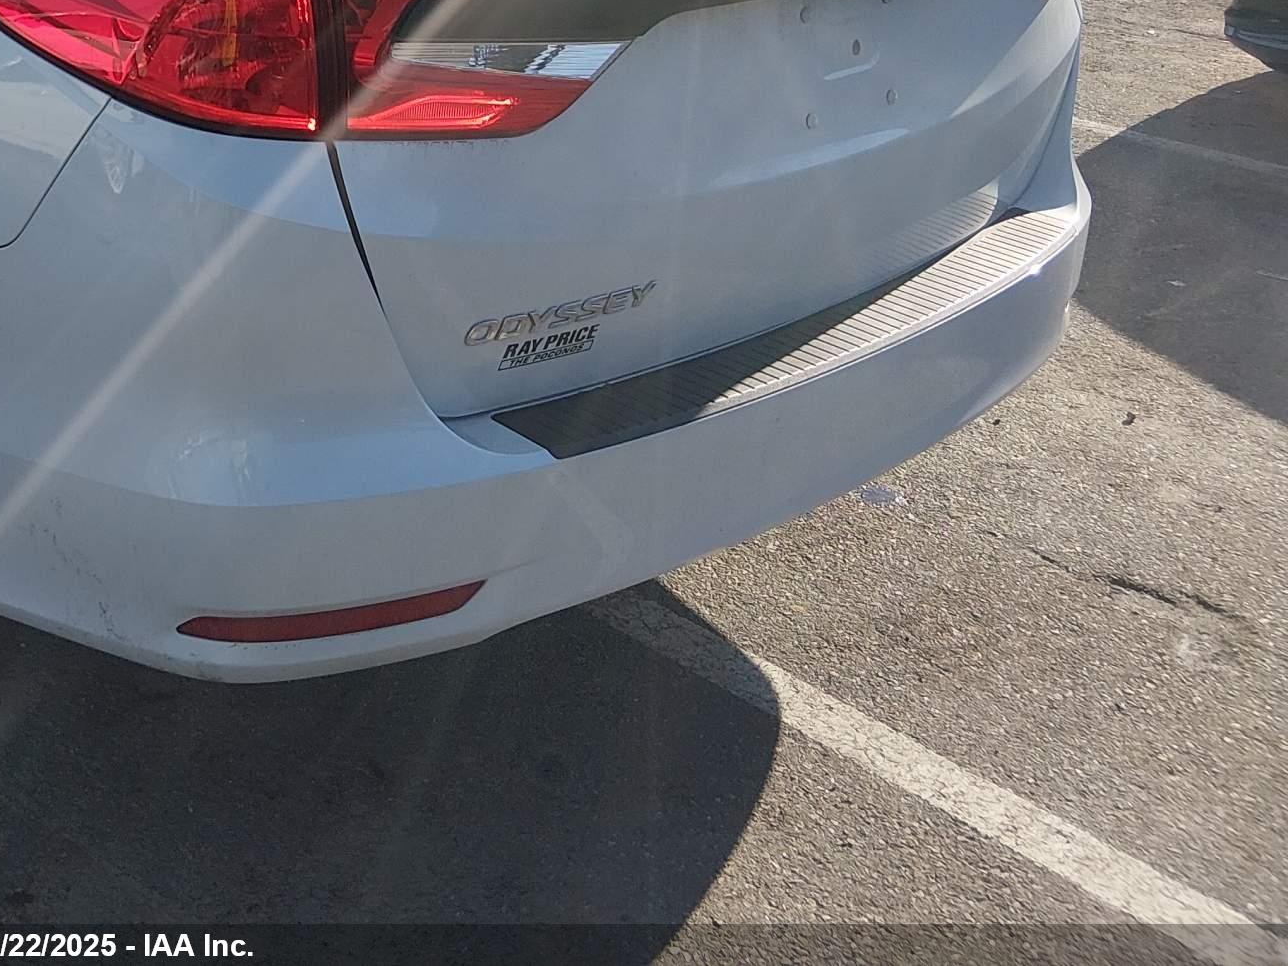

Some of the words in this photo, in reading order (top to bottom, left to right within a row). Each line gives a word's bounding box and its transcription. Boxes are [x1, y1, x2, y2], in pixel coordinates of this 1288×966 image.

[464, 279, 657, 346] ODYSSEY
[502, 337, 544, 359] RAY
[543, 324, 601, 350] PRICE
[509, 356, 531, 367] THE
[532, 343, 585, 362] POCONOS
